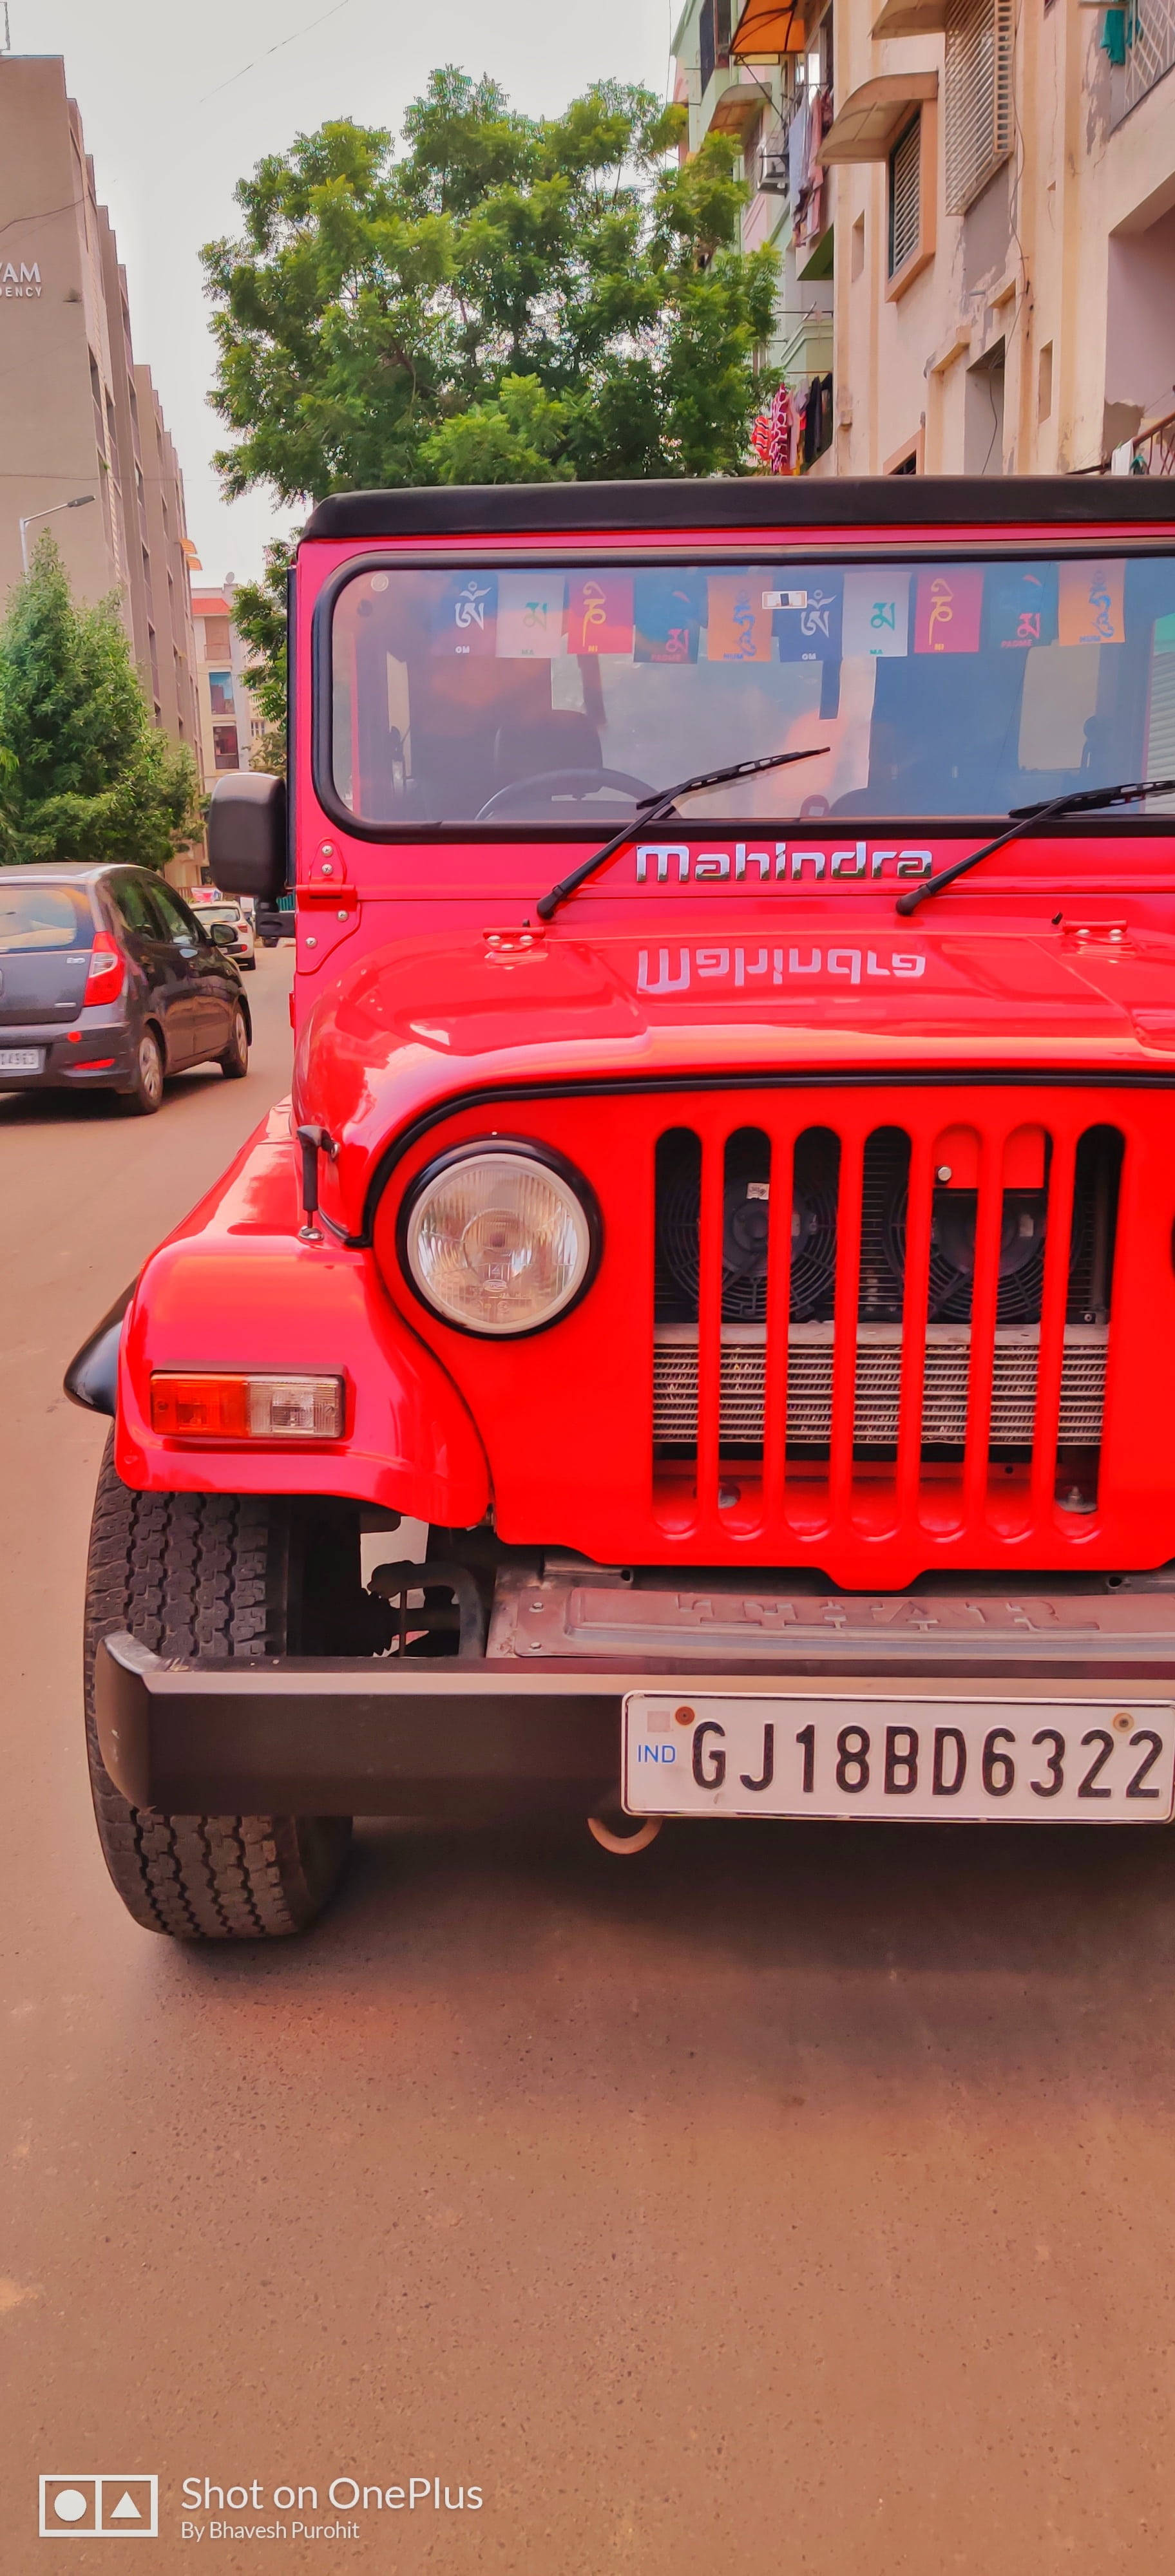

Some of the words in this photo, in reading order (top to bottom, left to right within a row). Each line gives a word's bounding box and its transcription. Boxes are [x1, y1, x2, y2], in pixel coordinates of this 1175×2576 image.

[0, 262, 41, 283] AM
[455, 645, 470, 654] OM
[636, 842, 933, 882] Mahindra
[636, 1744, 676, 1764] IND
[691, 1720, 1163, 1799] GJ18BD6322
